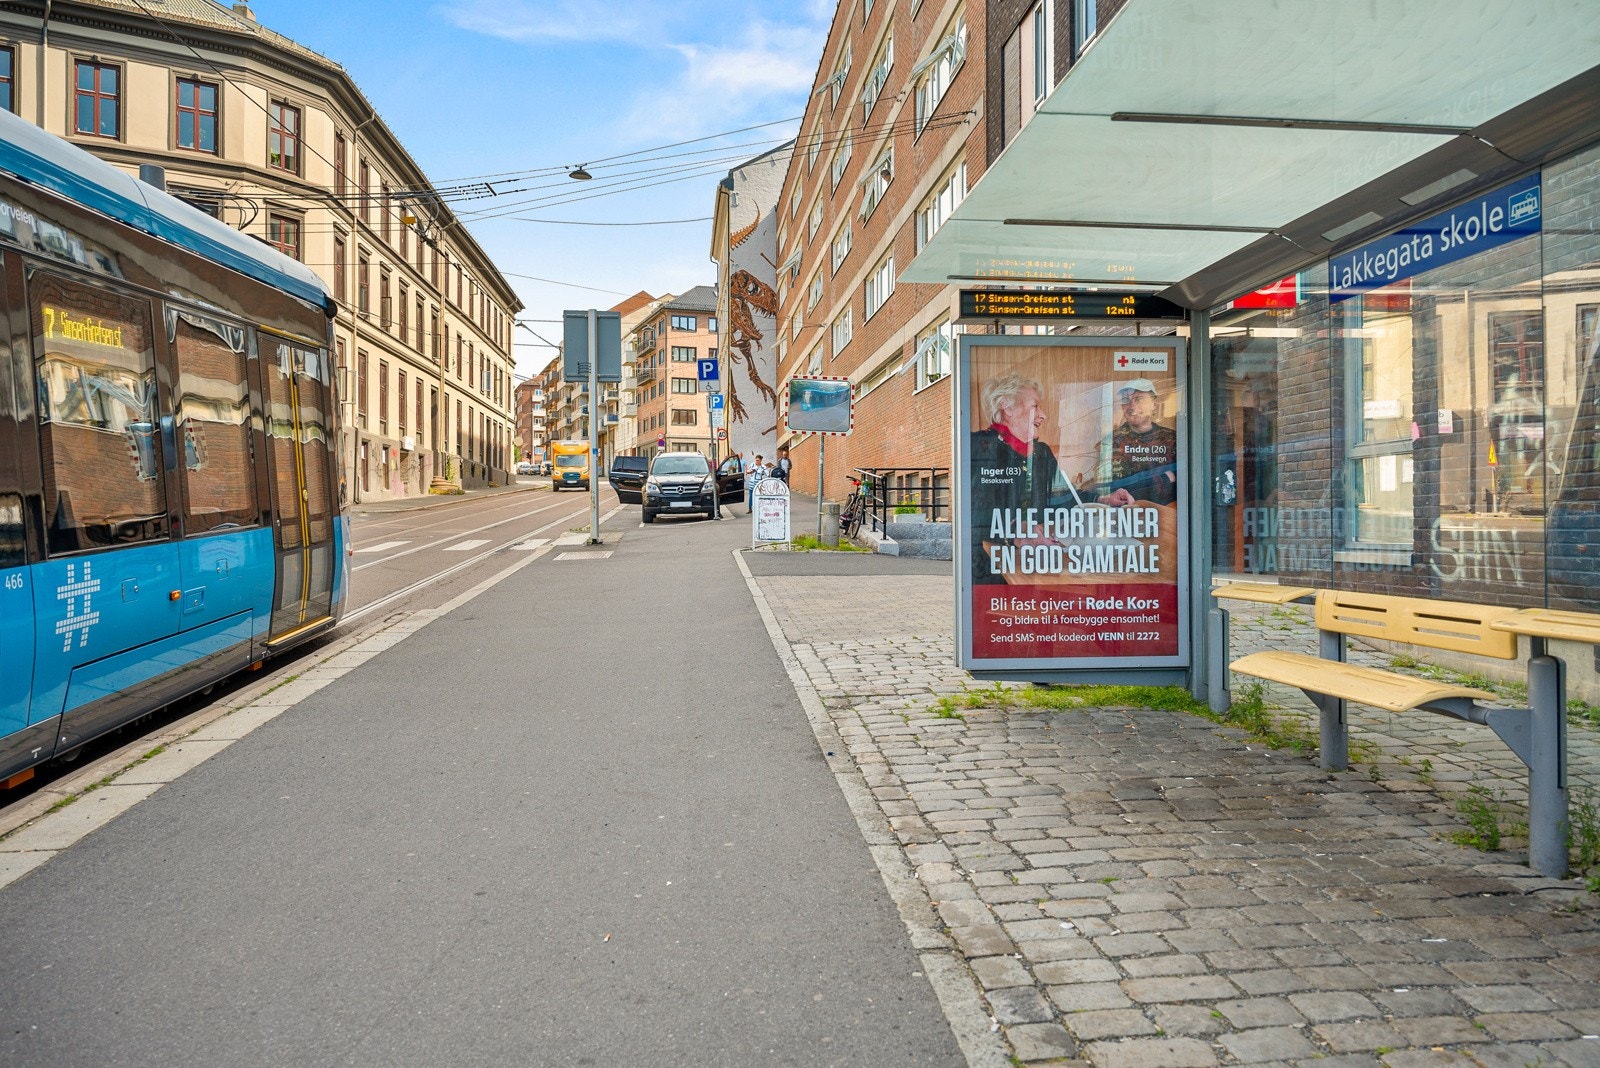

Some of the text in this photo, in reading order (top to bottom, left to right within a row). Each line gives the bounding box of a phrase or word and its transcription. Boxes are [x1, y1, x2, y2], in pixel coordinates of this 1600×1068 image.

[1333, 201, 1504, 291] Lakkegata skole
[975, 294, 1135, 304] 17 Sinsen-Grefsen st. nå
[975, 305, 1135, 315] 17 Sinsen-Grefsen st. 12min
[43, 307, 55, 339] 7
[1131, 357, 1165, 365] Røde Kors
[702, 361, 714, 378] P
[712, 396, 720, 408] P
[1124, 445, 1167, 455] Endre (26)
[980, 467, 1022, 477] Inger (83)
[990, 507, 1159, 538] ALLE FORTJENER
[990, 544, 1160, 575] EN GOD SAMTALE
[5, 572, 23, 590] 466
[990, 596, 1159, 614] Bli fast giver i Røde Kors
[999, 617, 1013, 627] og
[1014, 615, 1039, 625] bidra
[1041, 615, 1051, 624] til
[1052, 614, 1058, 624] å
[1060, 614, 1108, 627] forebygge
[1110, 613, 1160, 624] ensomhet!
[990, 631, 1160, 642] Send SMS med kodeord VENN til 2272
